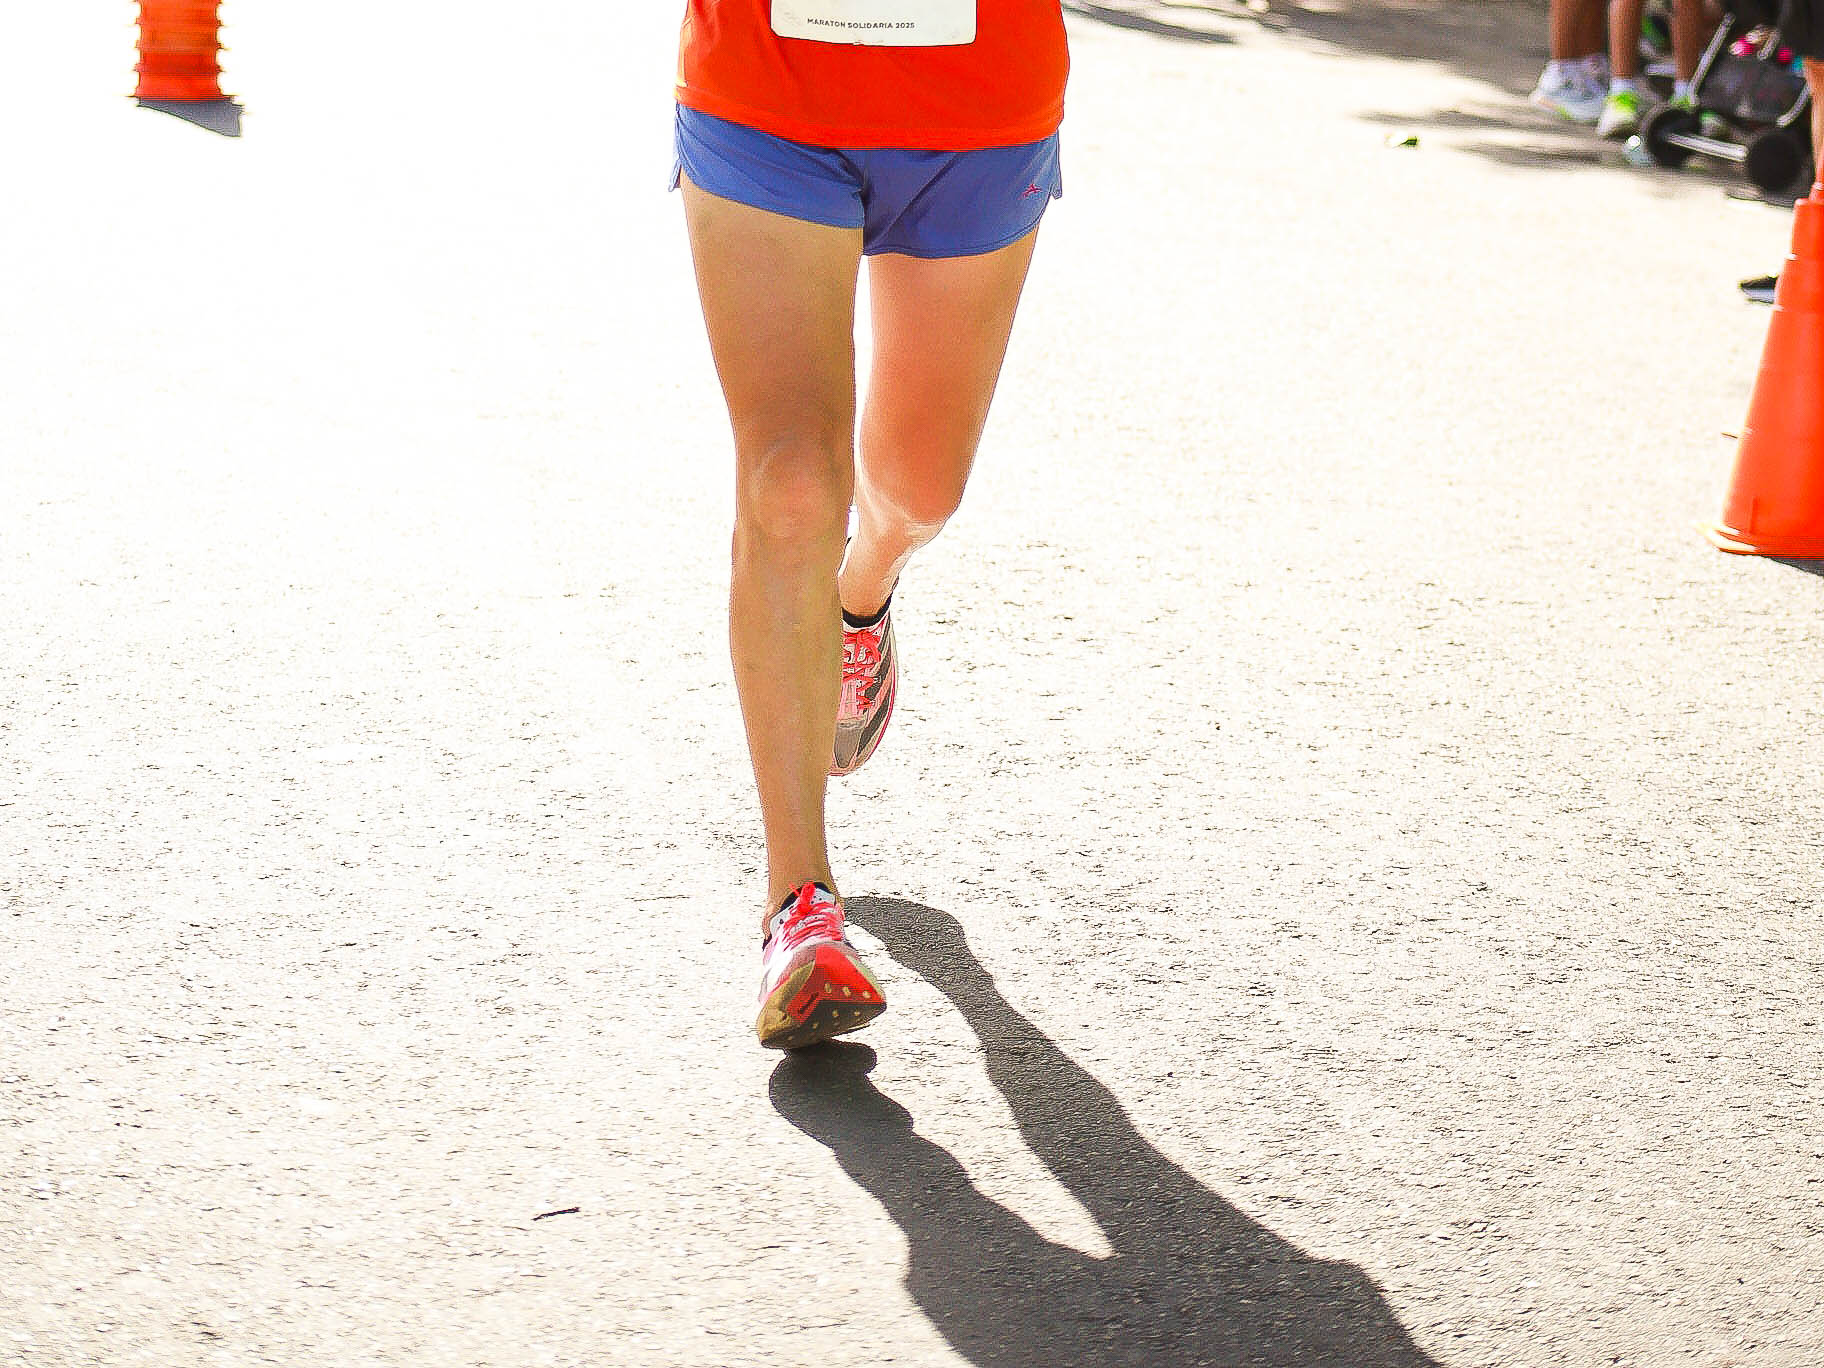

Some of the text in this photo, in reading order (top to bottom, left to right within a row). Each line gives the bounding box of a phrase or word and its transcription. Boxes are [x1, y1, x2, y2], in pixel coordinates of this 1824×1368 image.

[807, 18, 916, 30] MARATON SOLIDARIA 2025
